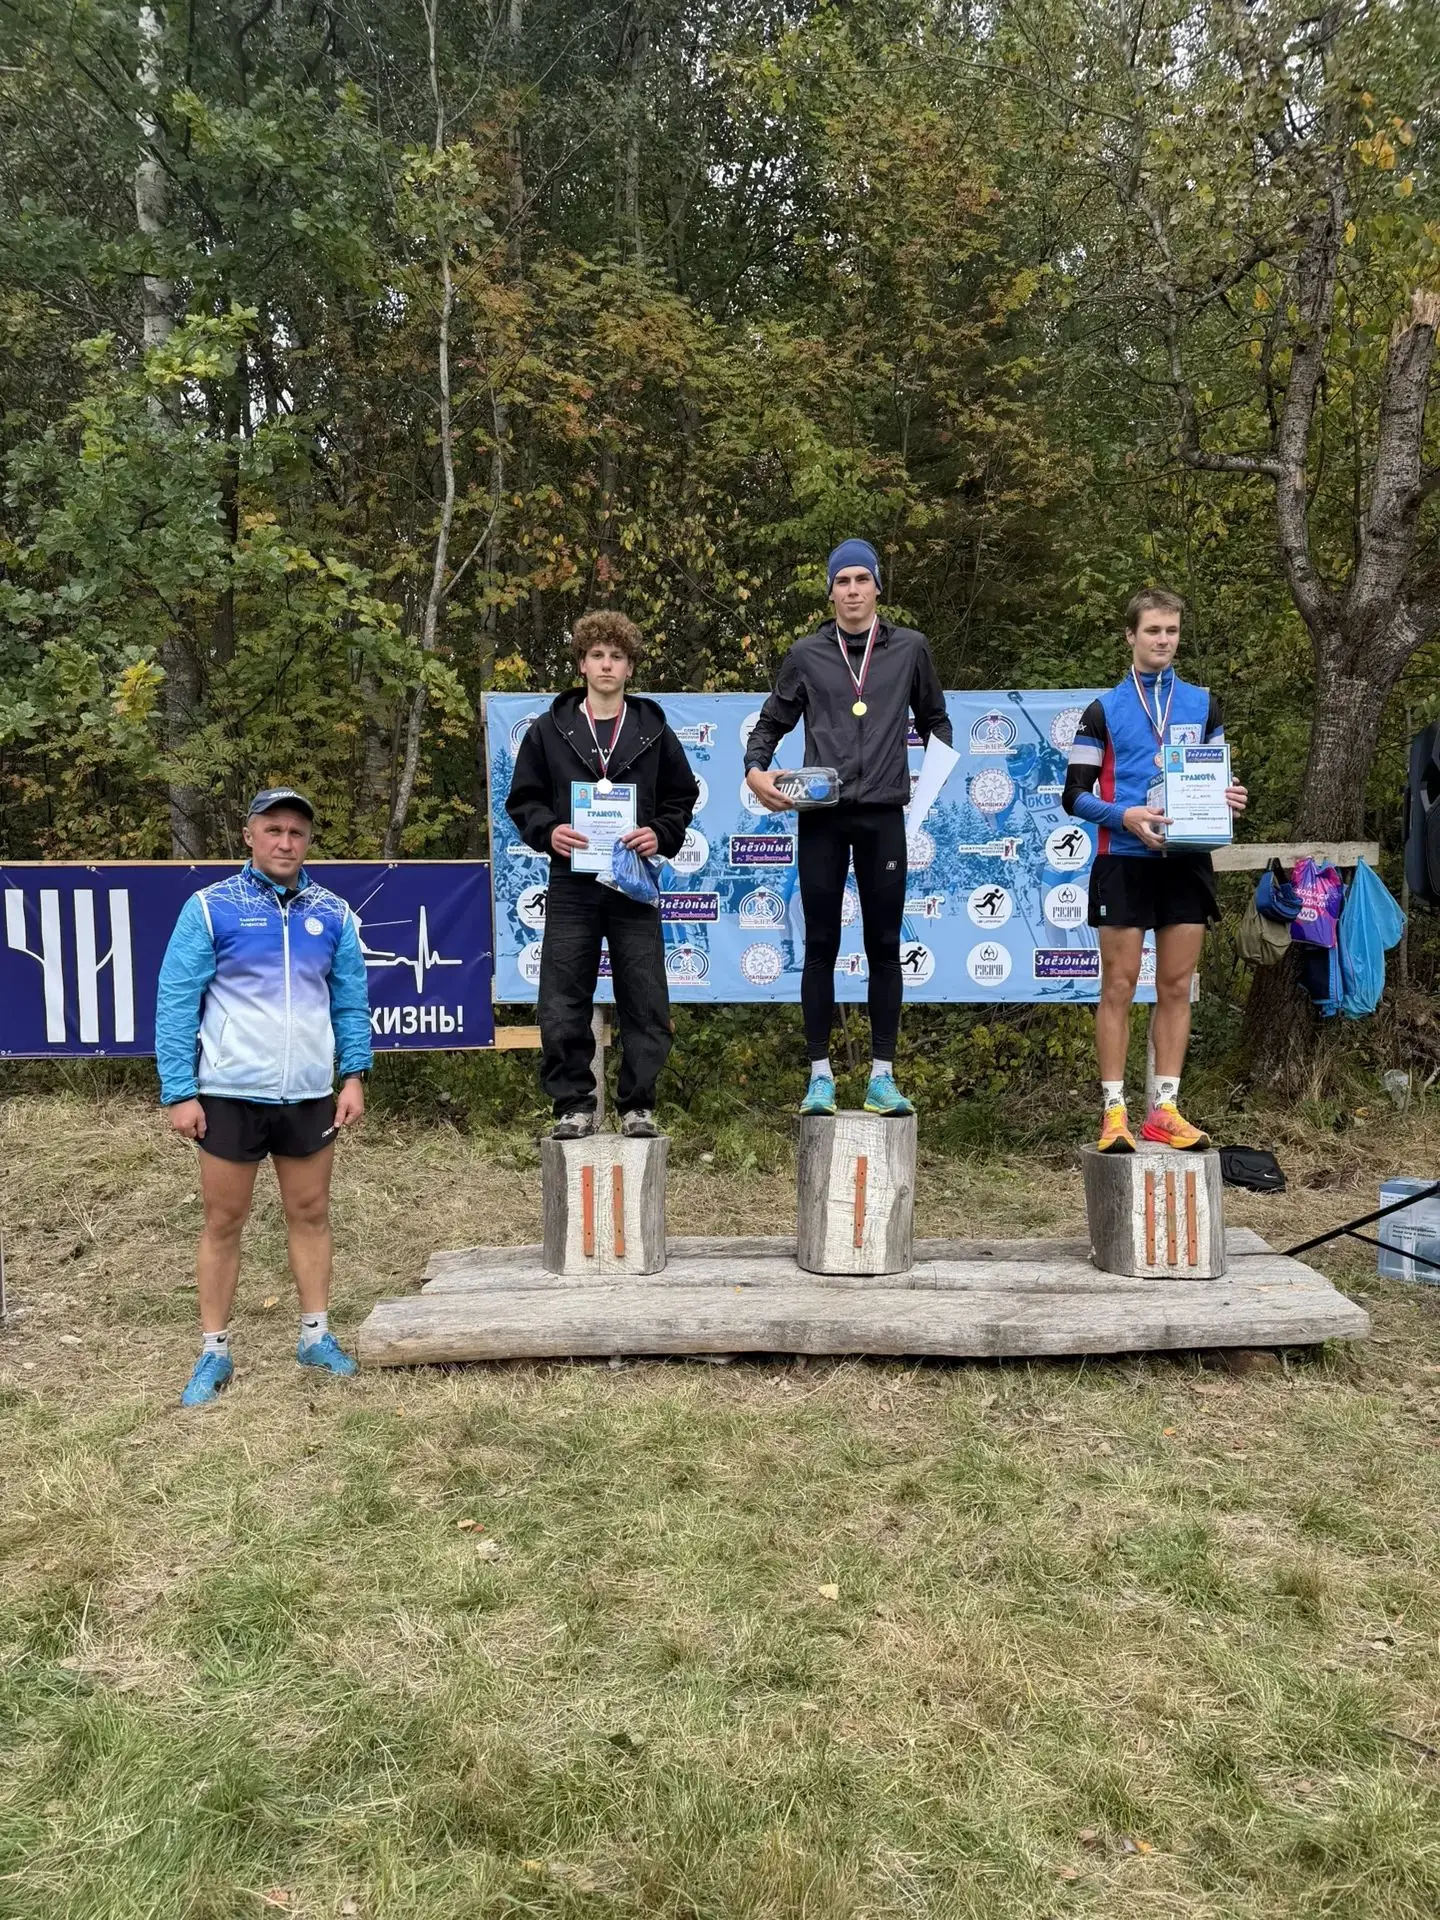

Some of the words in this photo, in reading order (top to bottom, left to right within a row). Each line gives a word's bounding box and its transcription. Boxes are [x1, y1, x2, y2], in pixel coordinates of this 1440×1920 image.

[732, 841, 792, 852] Звёздный
[1300, 909, 1316, 919] wb
[1036, 954, 1098, 965] Звёздный
